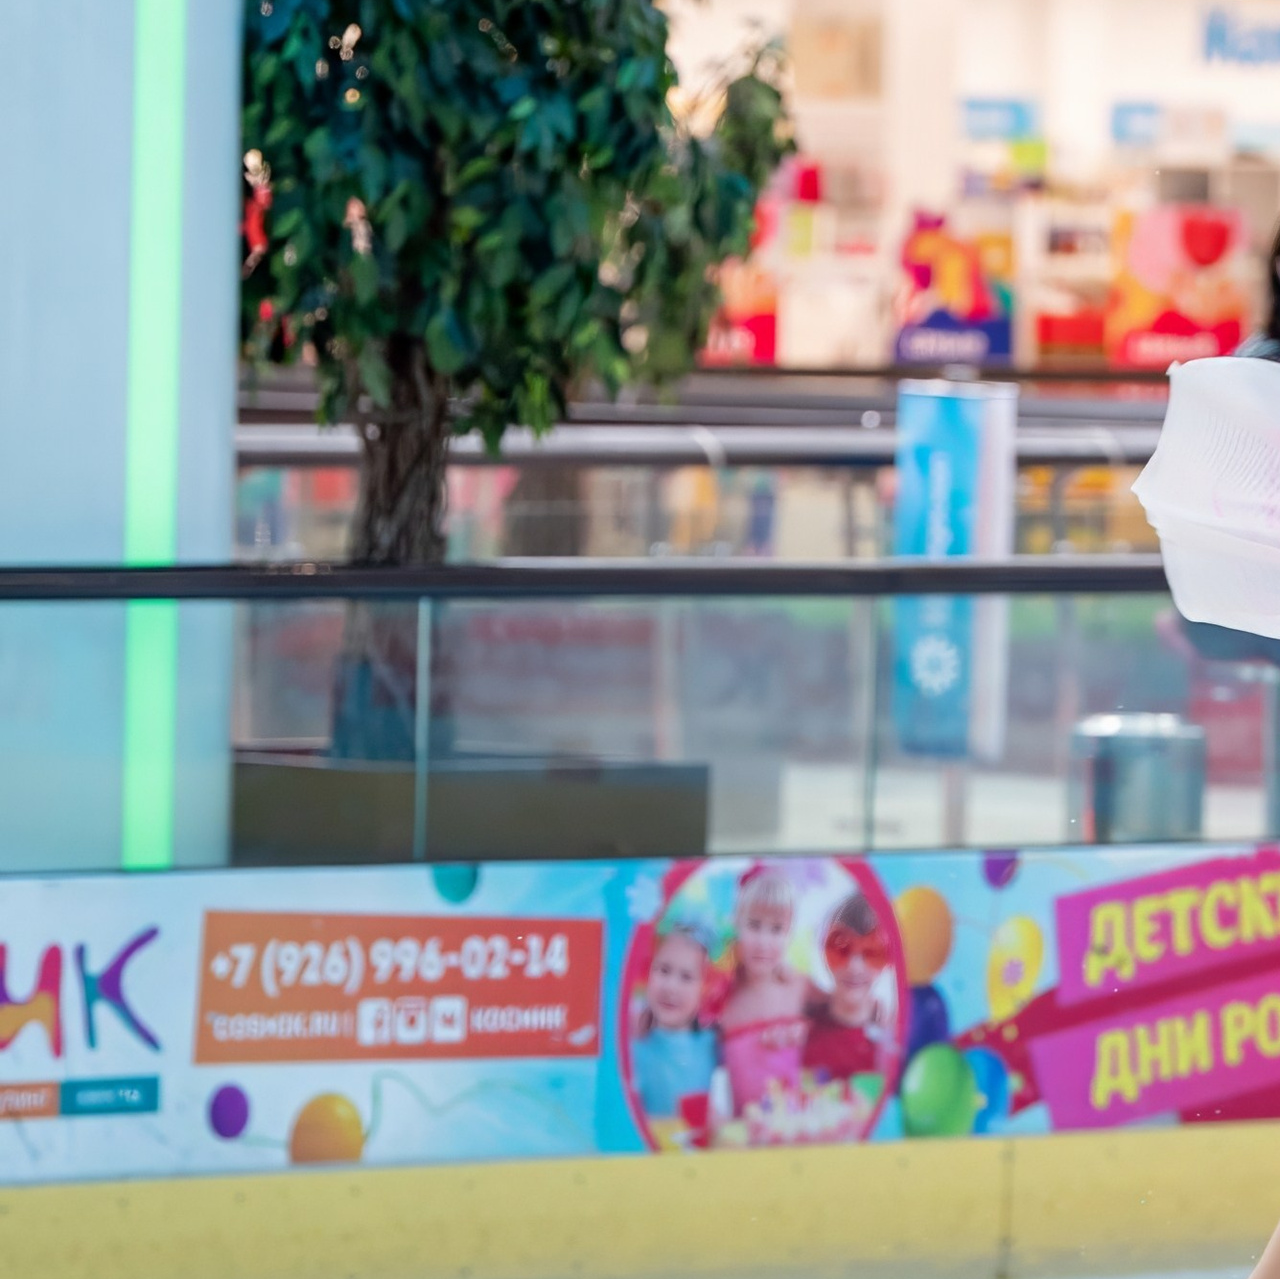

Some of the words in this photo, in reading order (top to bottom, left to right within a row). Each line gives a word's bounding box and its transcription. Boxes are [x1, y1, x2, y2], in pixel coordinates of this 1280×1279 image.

[210, 942, 256, 989] +7
[261, 936, 365, 998] (926)
[370, 933, 570, 984] 996-02-14
[1090, 1009, 1213, 1110] ДНИ
